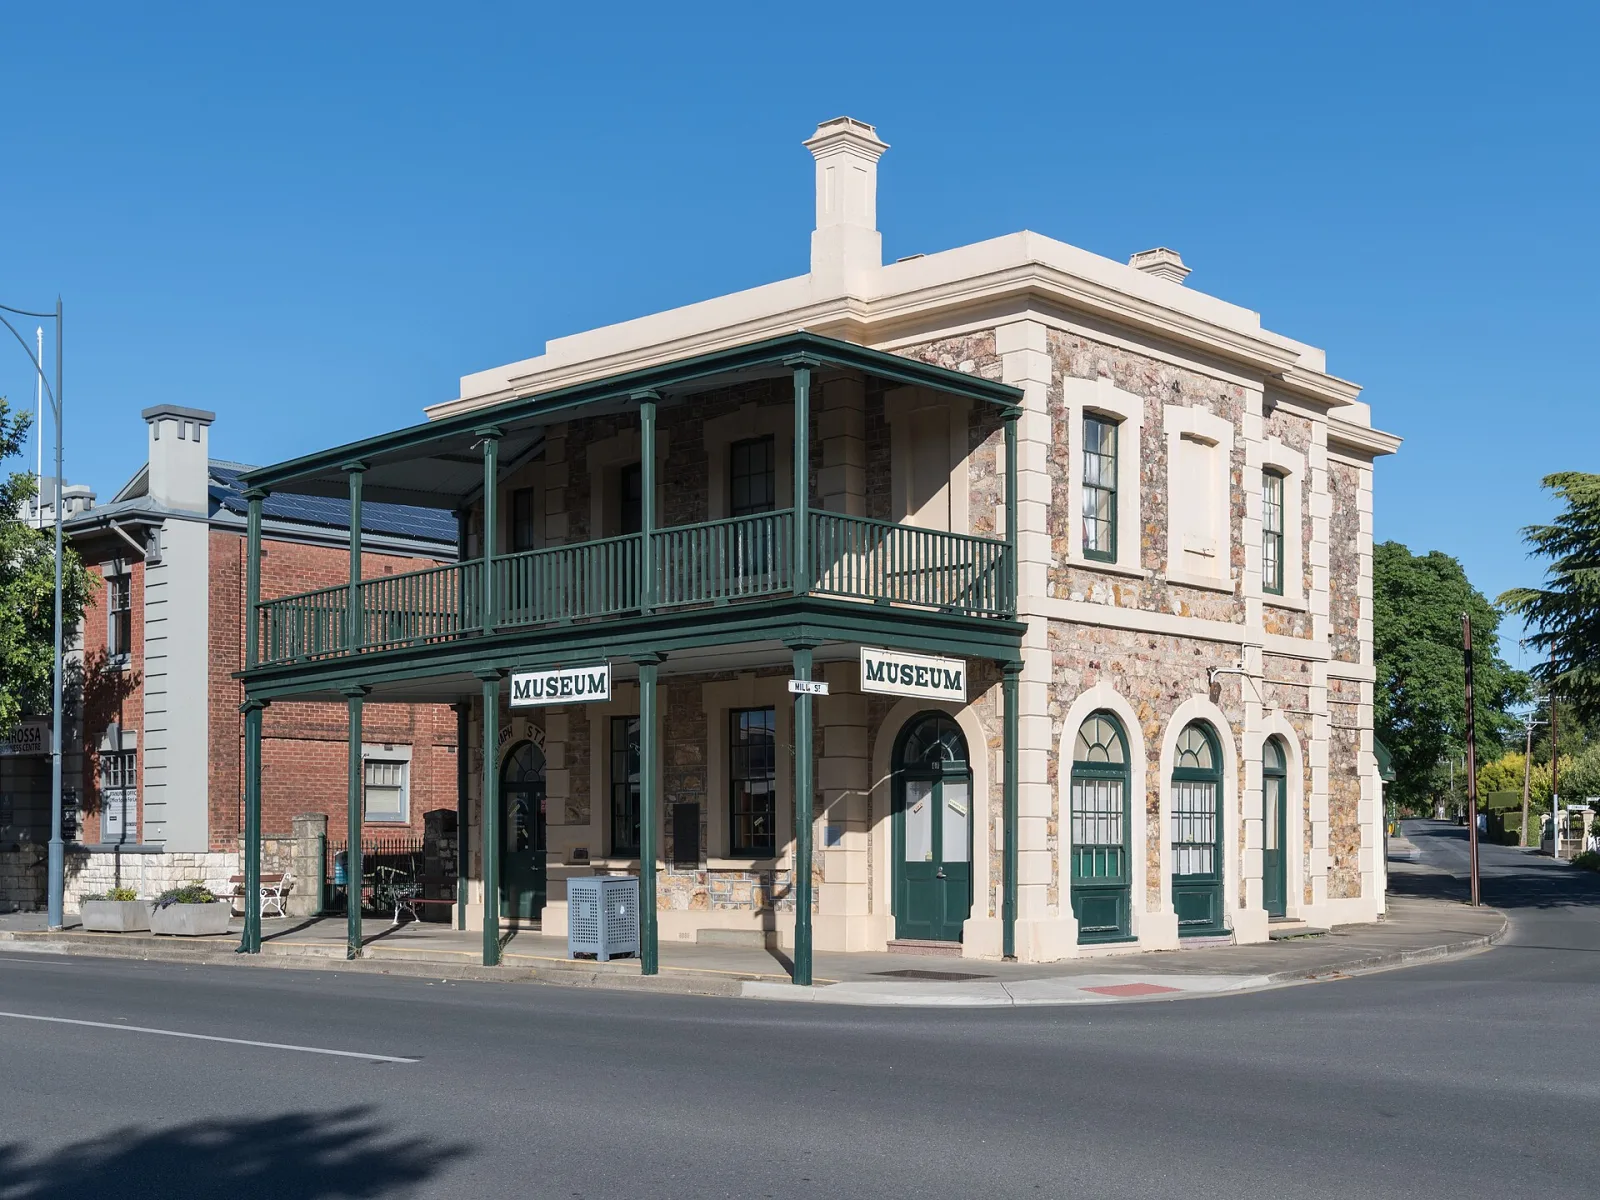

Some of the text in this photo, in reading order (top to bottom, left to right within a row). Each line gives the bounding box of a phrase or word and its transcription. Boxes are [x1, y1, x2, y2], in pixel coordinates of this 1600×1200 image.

[866, 659, 962, 691] MUSEUM
[513, 672, 606, 700] MUSEUM
[794, 682, 811, 691] MILL
[22, 742, 41, 752] CENTRE
